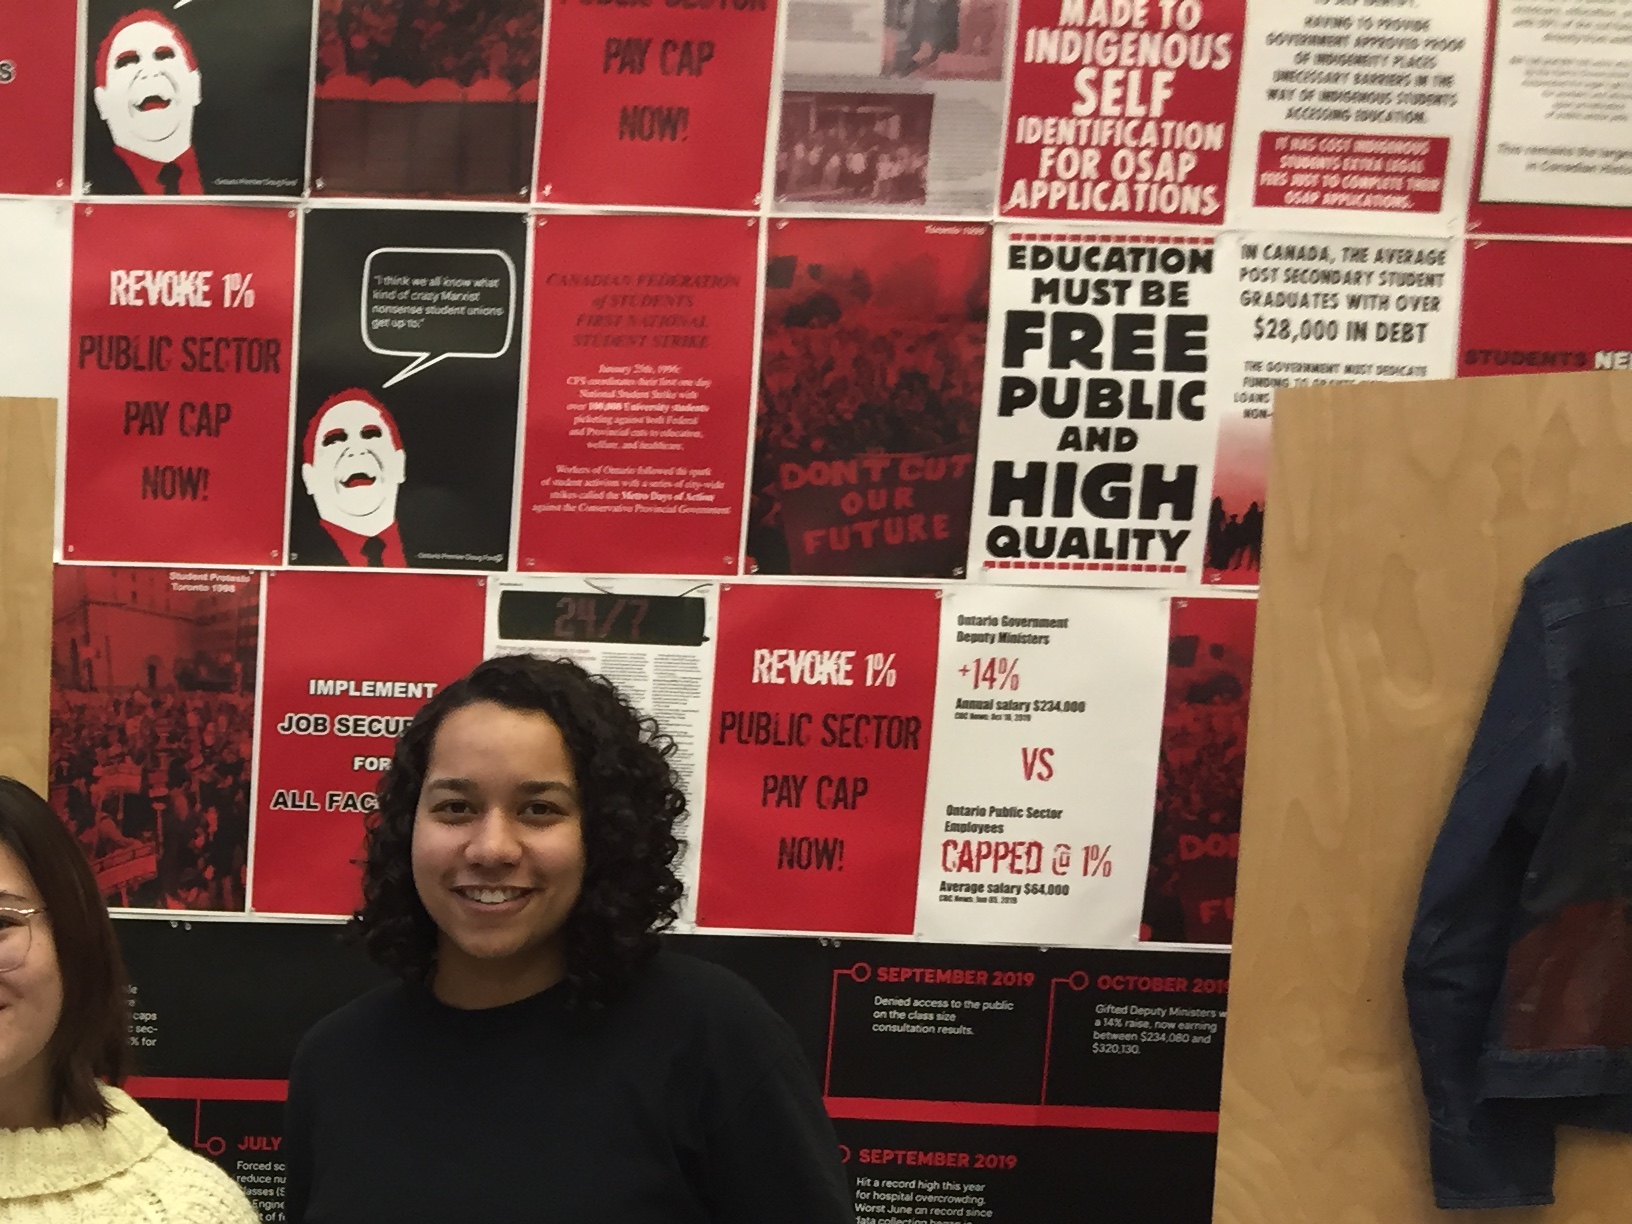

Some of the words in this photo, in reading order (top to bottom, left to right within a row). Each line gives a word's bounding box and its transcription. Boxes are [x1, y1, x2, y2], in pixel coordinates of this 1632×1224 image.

[1009, 245, 1213, 274] EDUCATION
[110, 270, 213, 307] REVOKE
[222, 273, 254, 308] 1%
[1032, 278, 1132, 306] MUST
[1141, 280, 1188, 307] BE
[79, 335, 172, 372] PUBLIC
[181, 336, 280, 373] SECTOR
[1002, 310, 1208, 372] FREE
[998, 376, 1206, 421] PUBLIC
[123, 401, 169, 436] PAY
[179, 402, 231, 437] CAP
[1057, 426, 1138, 452] AND
[142, 466, 210, 500] NOW!
[989, 461, 1198, 521] HIGH
[985, 525, 1192, 561] QUALITY
[877, 967, 988, 985] SEPTEMBER
[992, 971, 1034, 986] 2019
[860, 1149, 969, 1167] SEPTEMBER
[973, 1154, 1017, 1169] 2019
